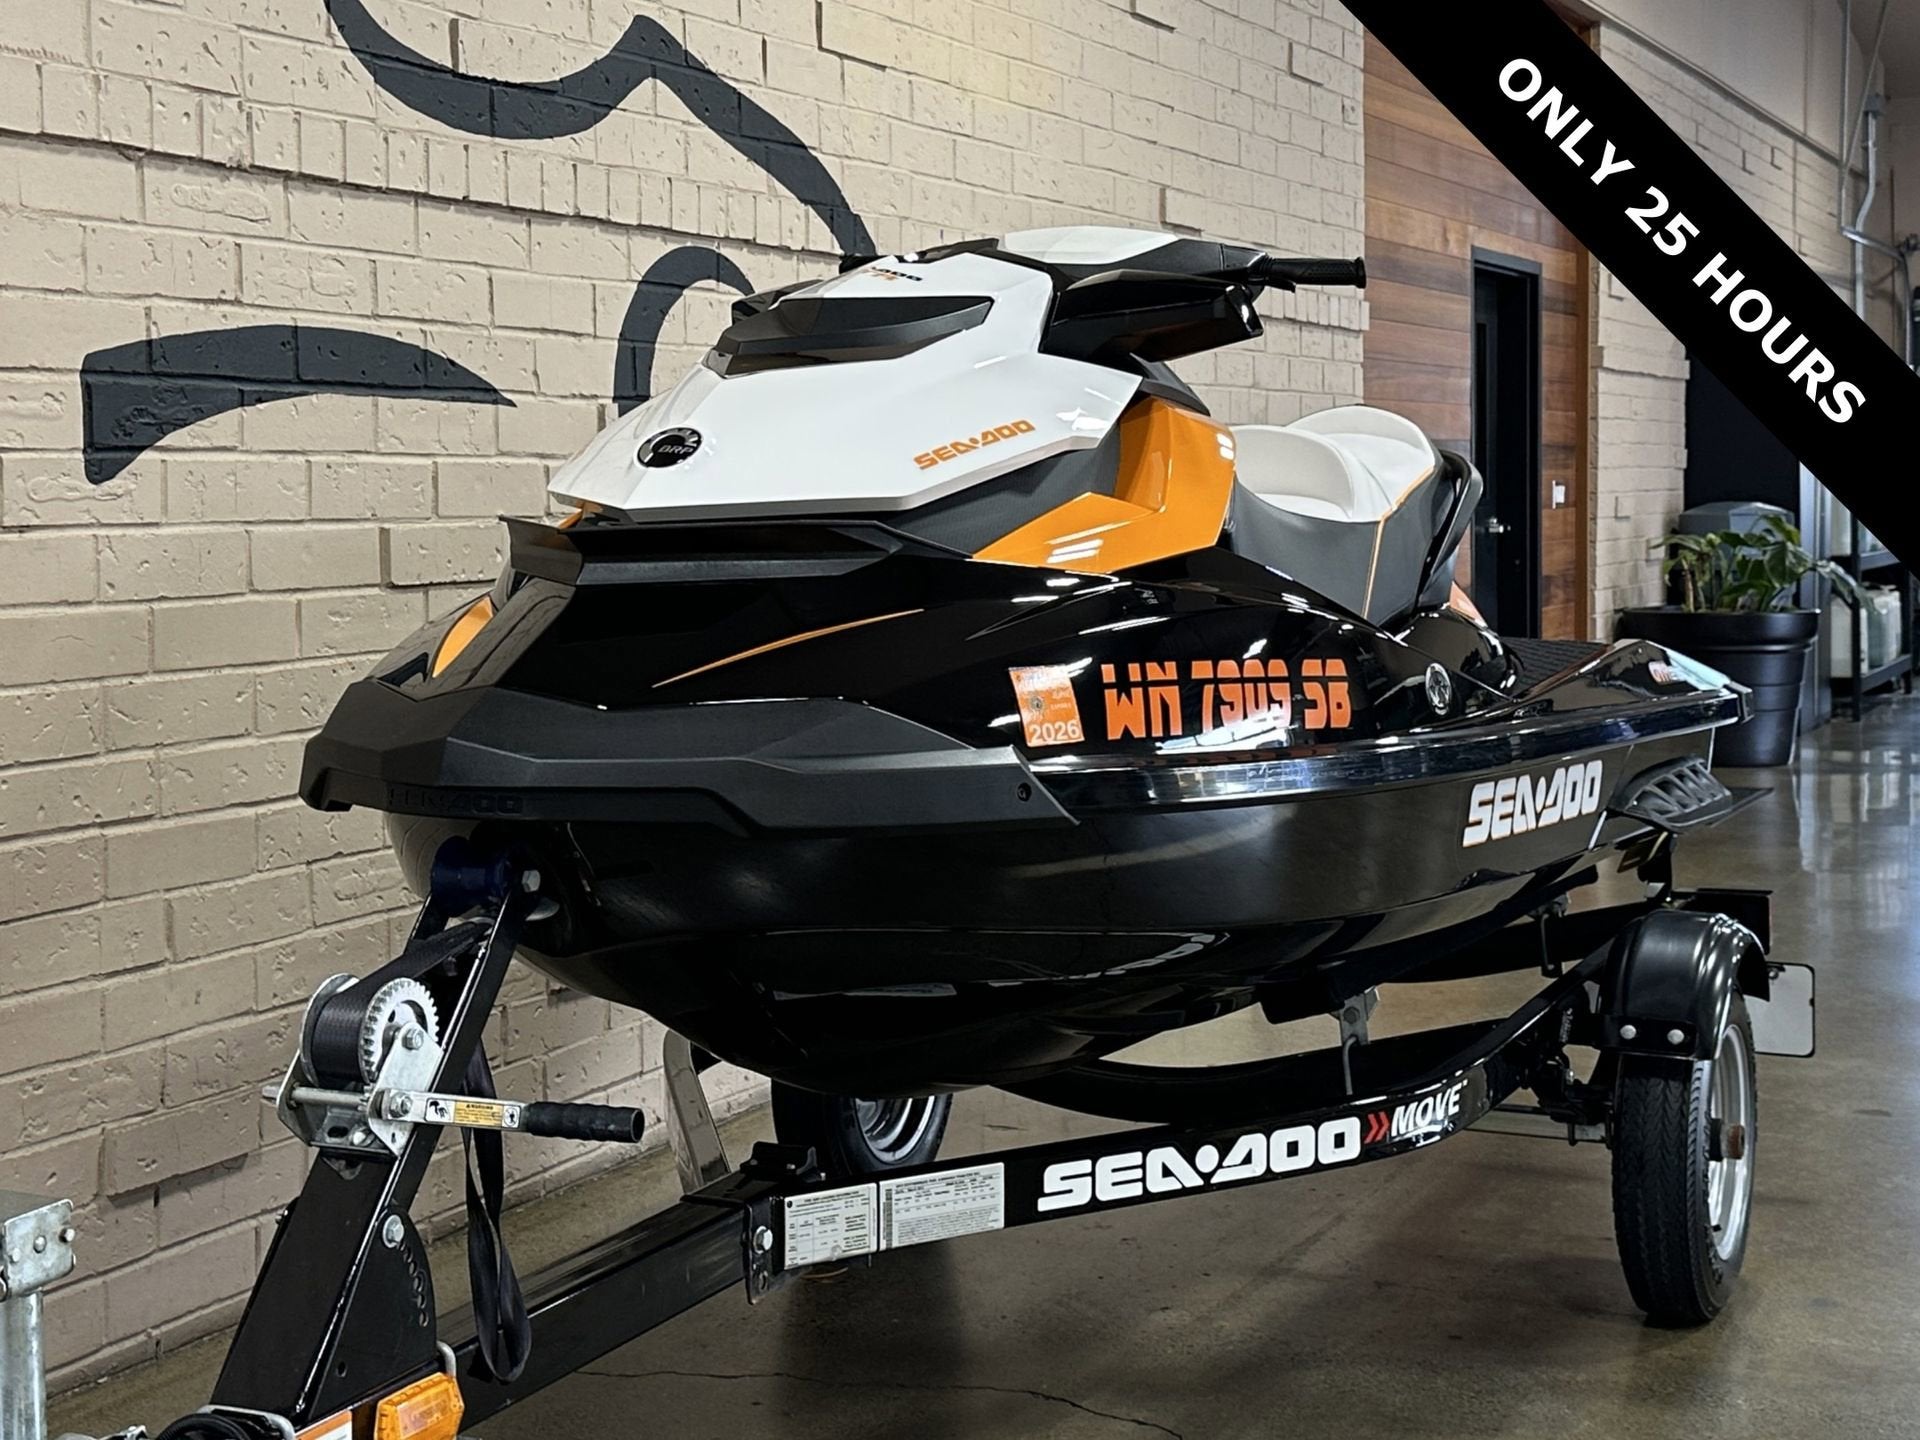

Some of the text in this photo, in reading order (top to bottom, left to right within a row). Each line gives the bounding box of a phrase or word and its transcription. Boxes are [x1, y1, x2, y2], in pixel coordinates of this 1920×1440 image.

[1100, 660, 1184, 741] WN
[1028, 719, 1080, 744] 2026
[1390, 1081, 1463, 1138] MOVE
